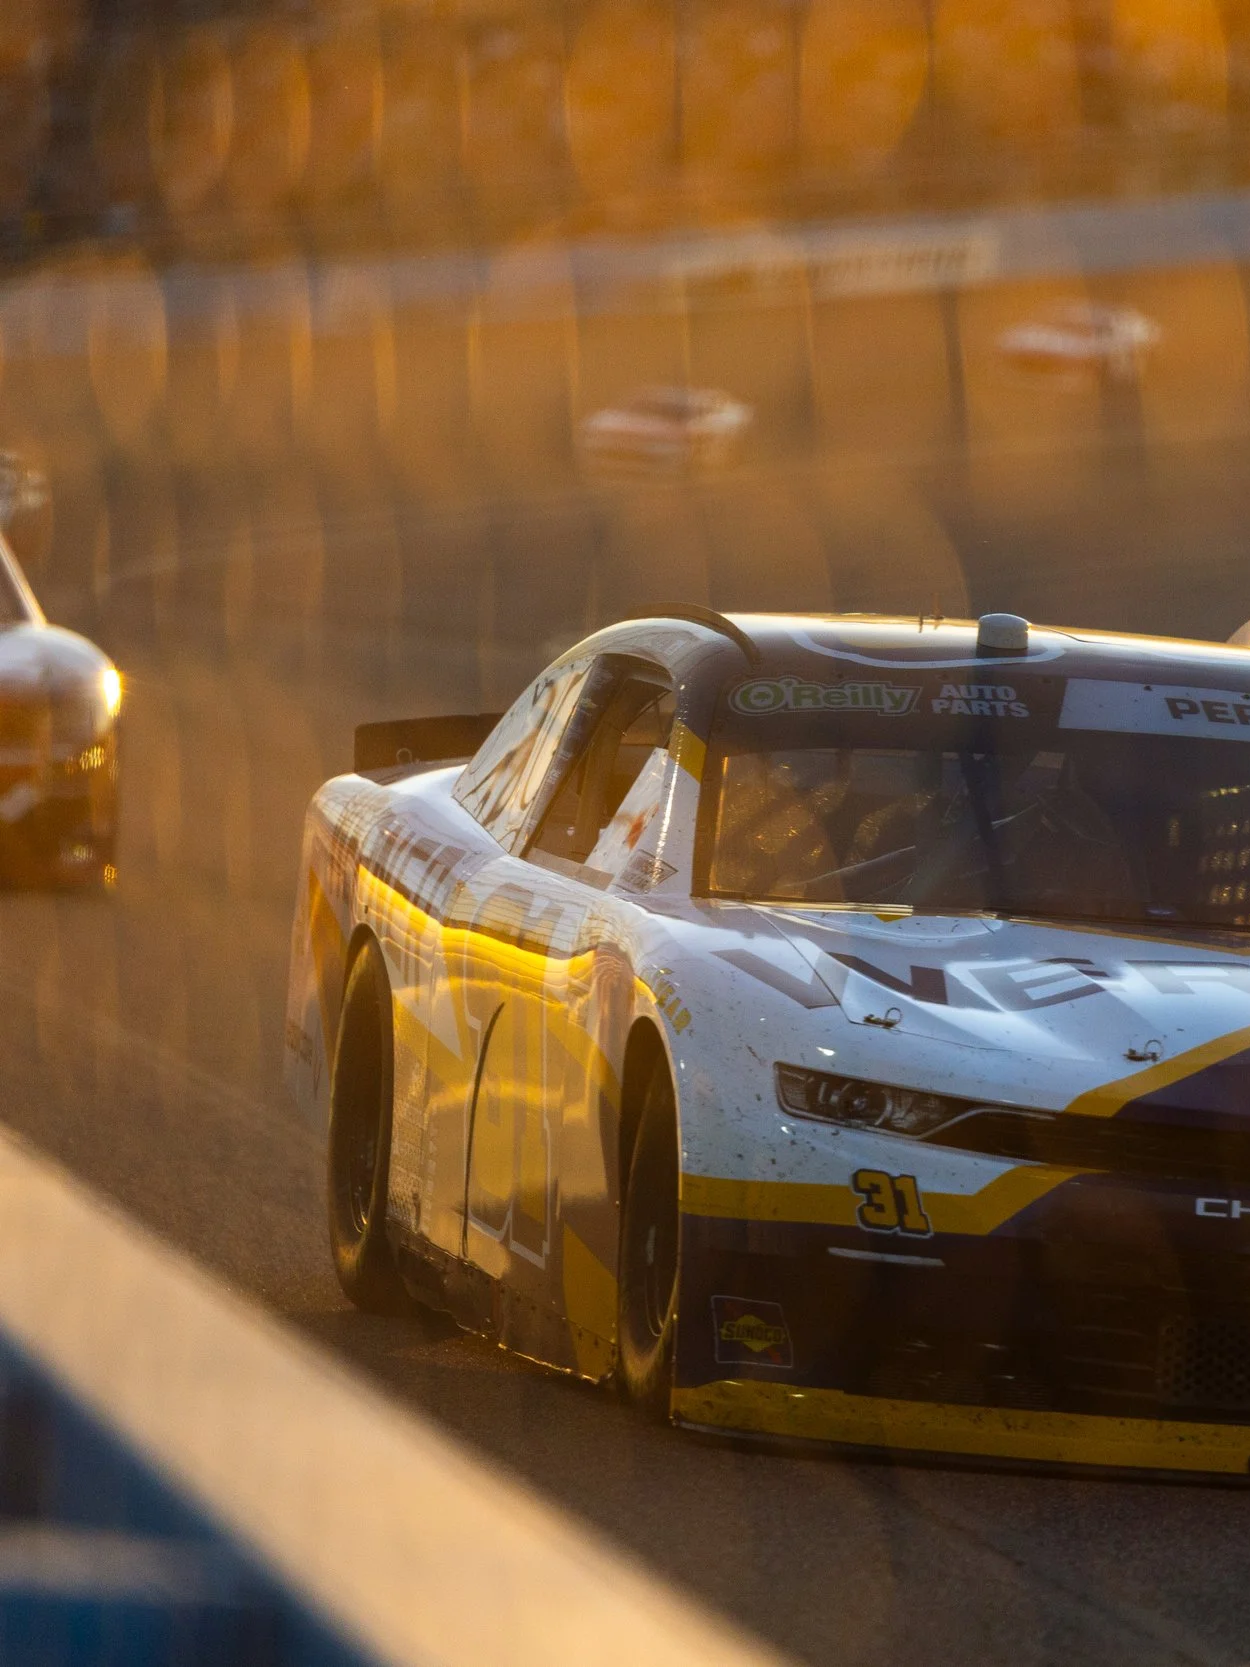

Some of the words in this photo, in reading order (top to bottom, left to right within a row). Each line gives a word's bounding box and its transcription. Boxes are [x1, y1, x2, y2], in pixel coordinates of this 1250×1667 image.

[734, 676, 913, 714] O'Reilly
[939, 683, 1017, 701] AUTO
[931, 699, 1030, 718] PARTS
[851, 1168, 934, 1239] 31
